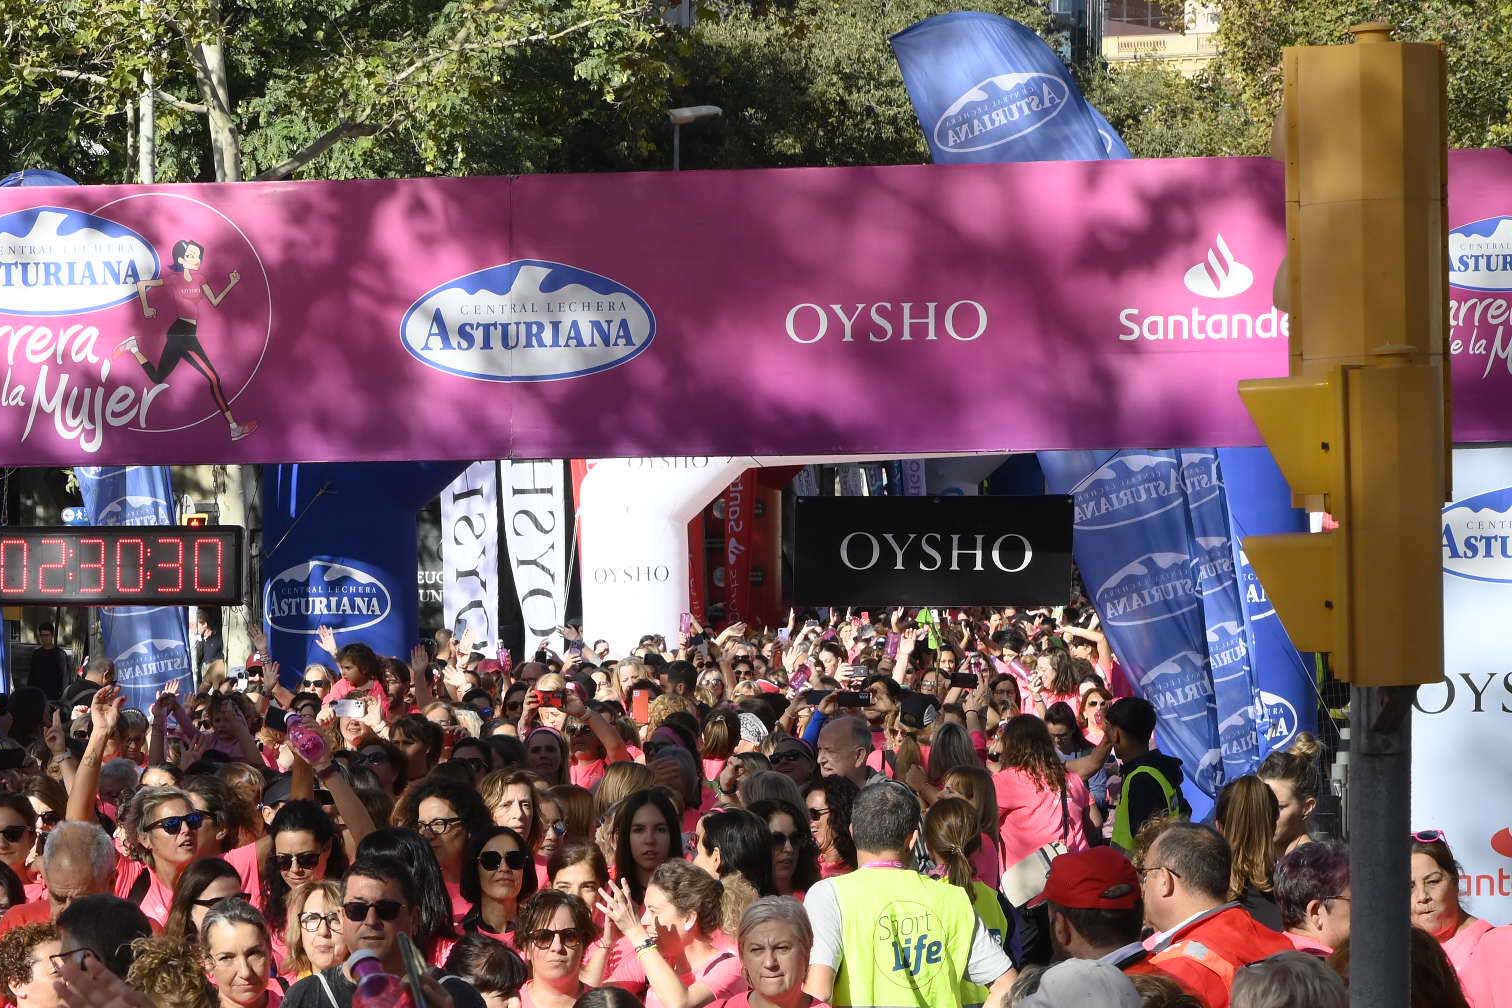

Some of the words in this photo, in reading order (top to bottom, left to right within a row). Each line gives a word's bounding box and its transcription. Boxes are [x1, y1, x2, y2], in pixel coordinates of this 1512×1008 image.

[420, 308, 637, 351] ASTURIANA
[460, 303, 539, 315] CENTRAL
[547, 301, 627, 313] LECHERA
[786, 299, 988, 344] OYSHO
[1, 370, 26, 407] la
[21, 359, 171, 452] Mujer
[0, 537, 223, 594] 02:30:30
[840, 531, 1034, 574] OYSHO
[593, 565, 670, 584] OYSHO
[270, 590, 382, 617] ASTURIANA
[892, 933, 943, 976] life
